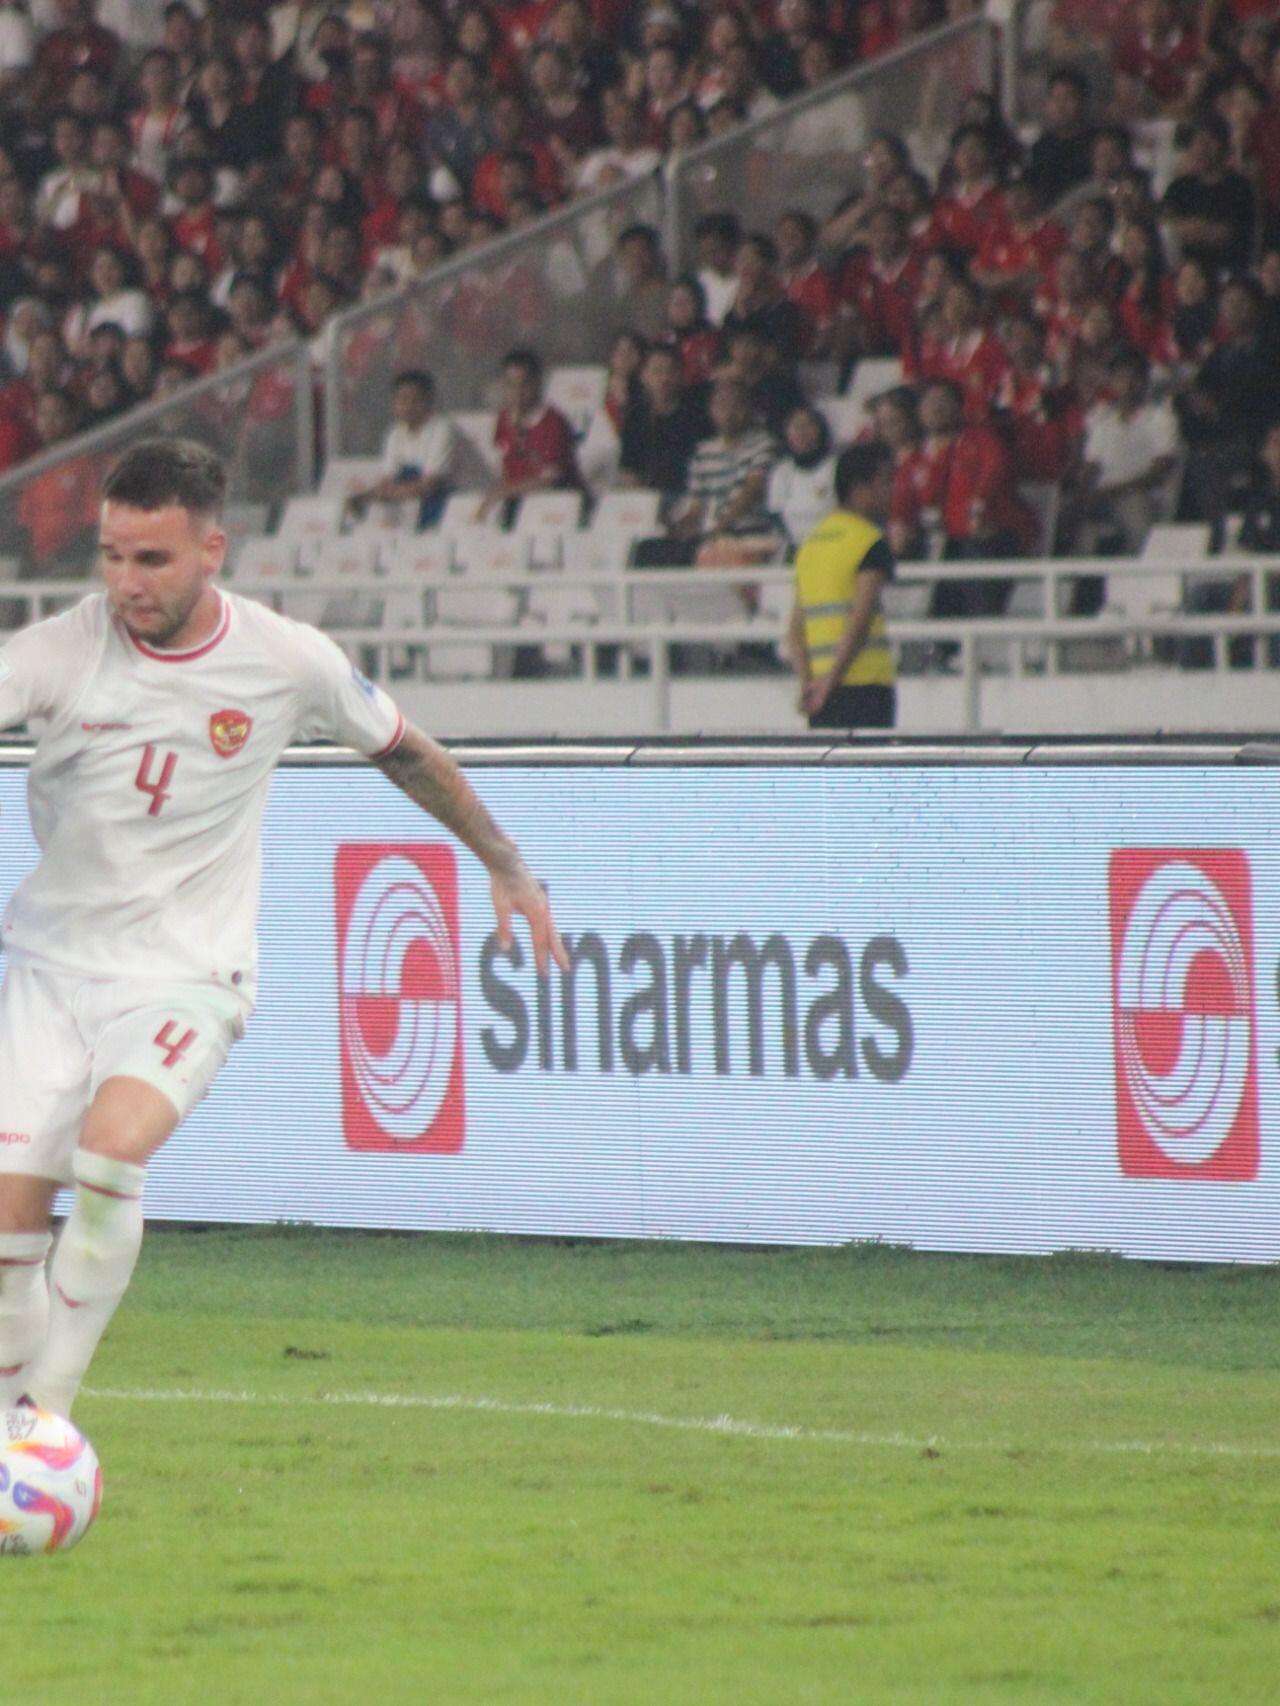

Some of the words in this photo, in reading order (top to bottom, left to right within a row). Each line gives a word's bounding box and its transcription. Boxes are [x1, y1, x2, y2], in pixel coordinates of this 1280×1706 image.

[134, 743, 178, 816] 4
[478, 882, 916, 1083] sinarmas
[153, 1019, 199, 1069] 4
